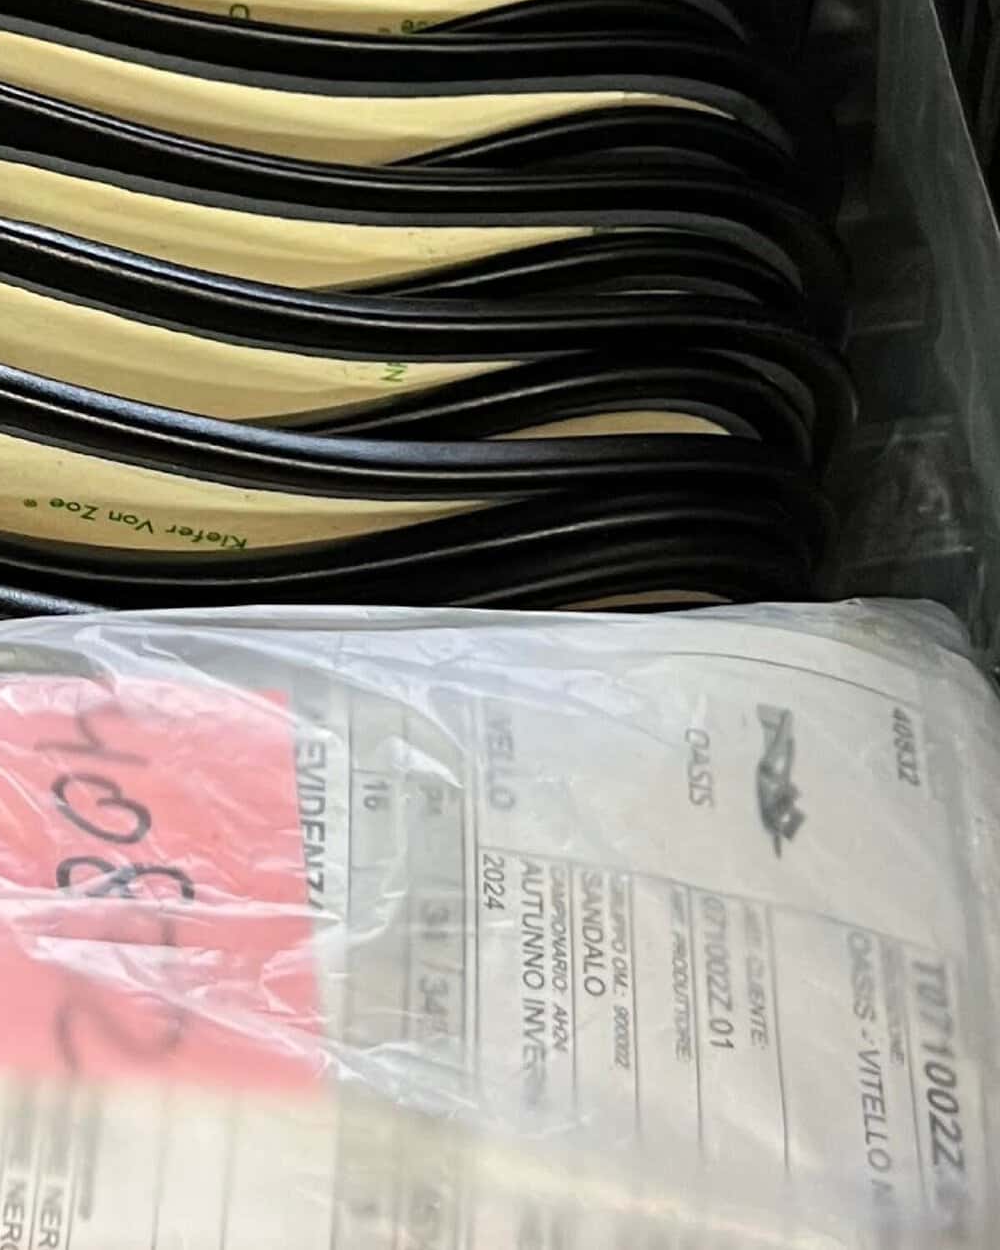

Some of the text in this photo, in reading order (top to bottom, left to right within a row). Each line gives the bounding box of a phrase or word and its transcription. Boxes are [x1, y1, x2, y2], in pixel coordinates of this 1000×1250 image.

[49, 498, 98, 521] Zoe
[108, 510, 154, 535] Von
[165, 524, 248, 550] Kiefer
[685, 726, 715, 807] OASIS
[481, 852, 506, 912] 2024
[519, 859, 546, 991] AUTUNNO
[580, 872, 608, 999] SANDALO
[858, 1049, 893, 1187] VITELLO
